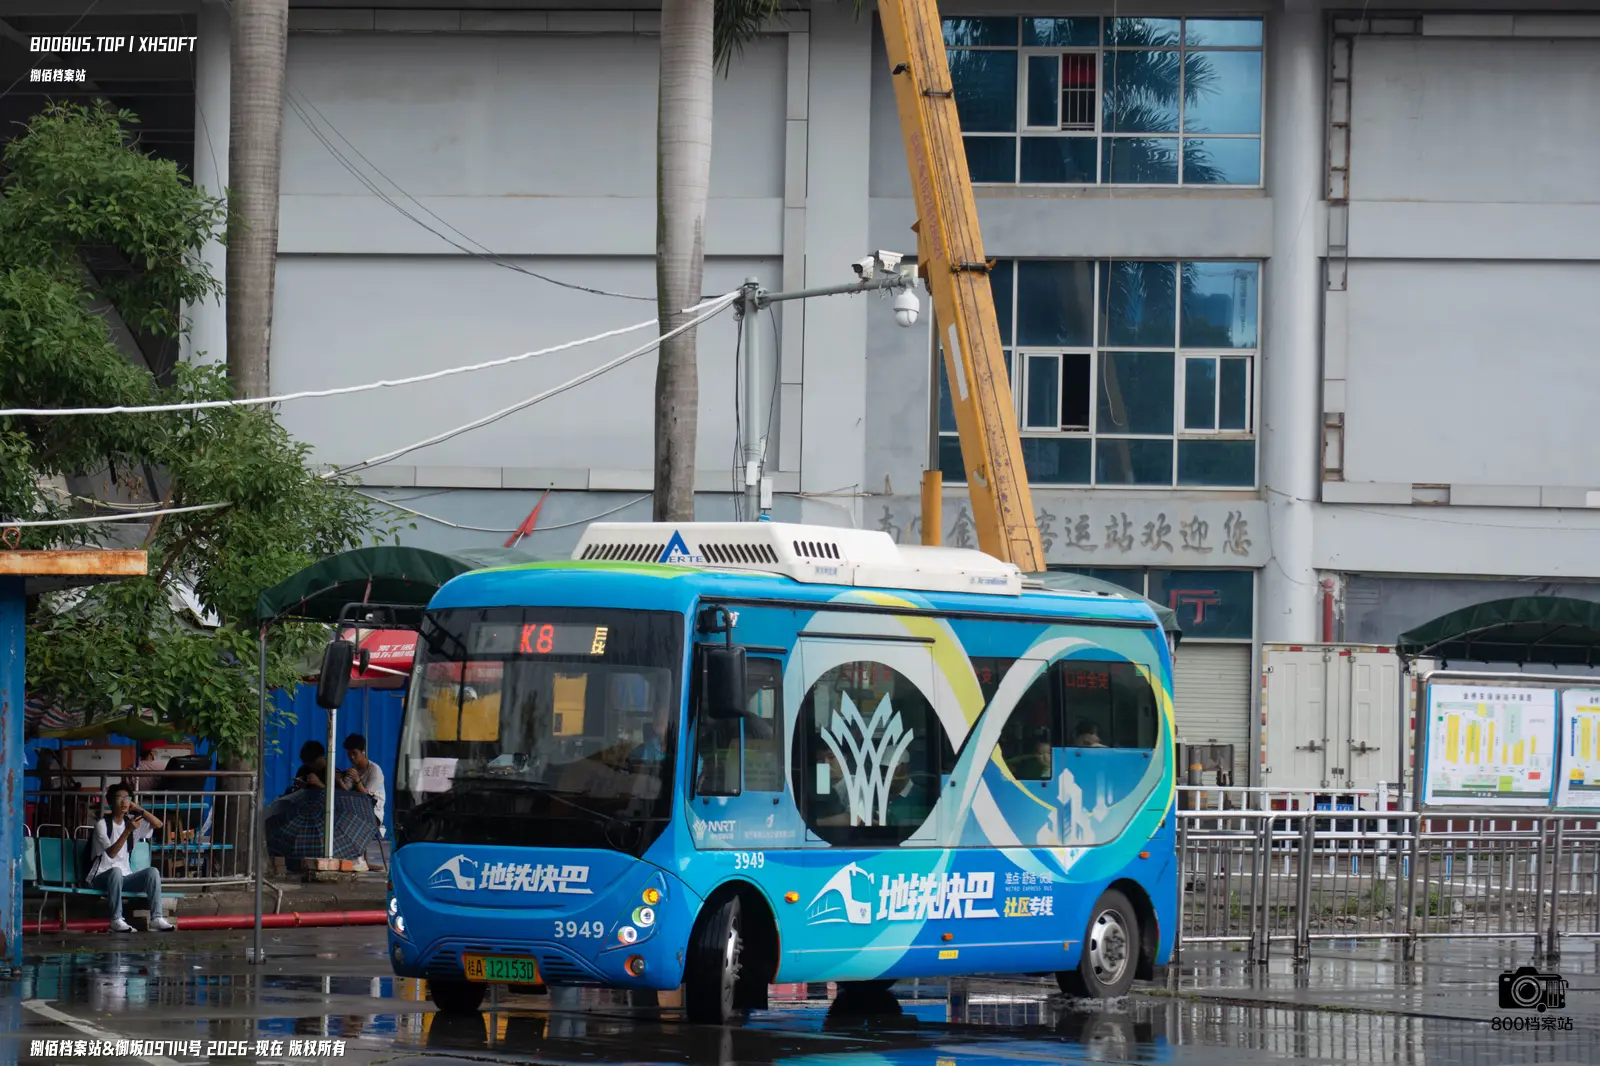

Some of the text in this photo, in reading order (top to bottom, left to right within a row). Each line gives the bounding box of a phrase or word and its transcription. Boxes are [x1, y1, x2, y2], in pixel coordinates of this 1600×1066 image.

[878, 504, 1252, 557] 南金客运站欢迎您
[1170, 589, 1220, 624] 厅
[519, 623, 554, 653] K8
[734, 852, 765, 870] 3949
[479, 862, 594, 895] 地铁快巴
[876, 872, 1000, 921] 地铁快巴
[1003, 896, 1055, 918] 社区专线
[554, 920, 605, 939] 3949
